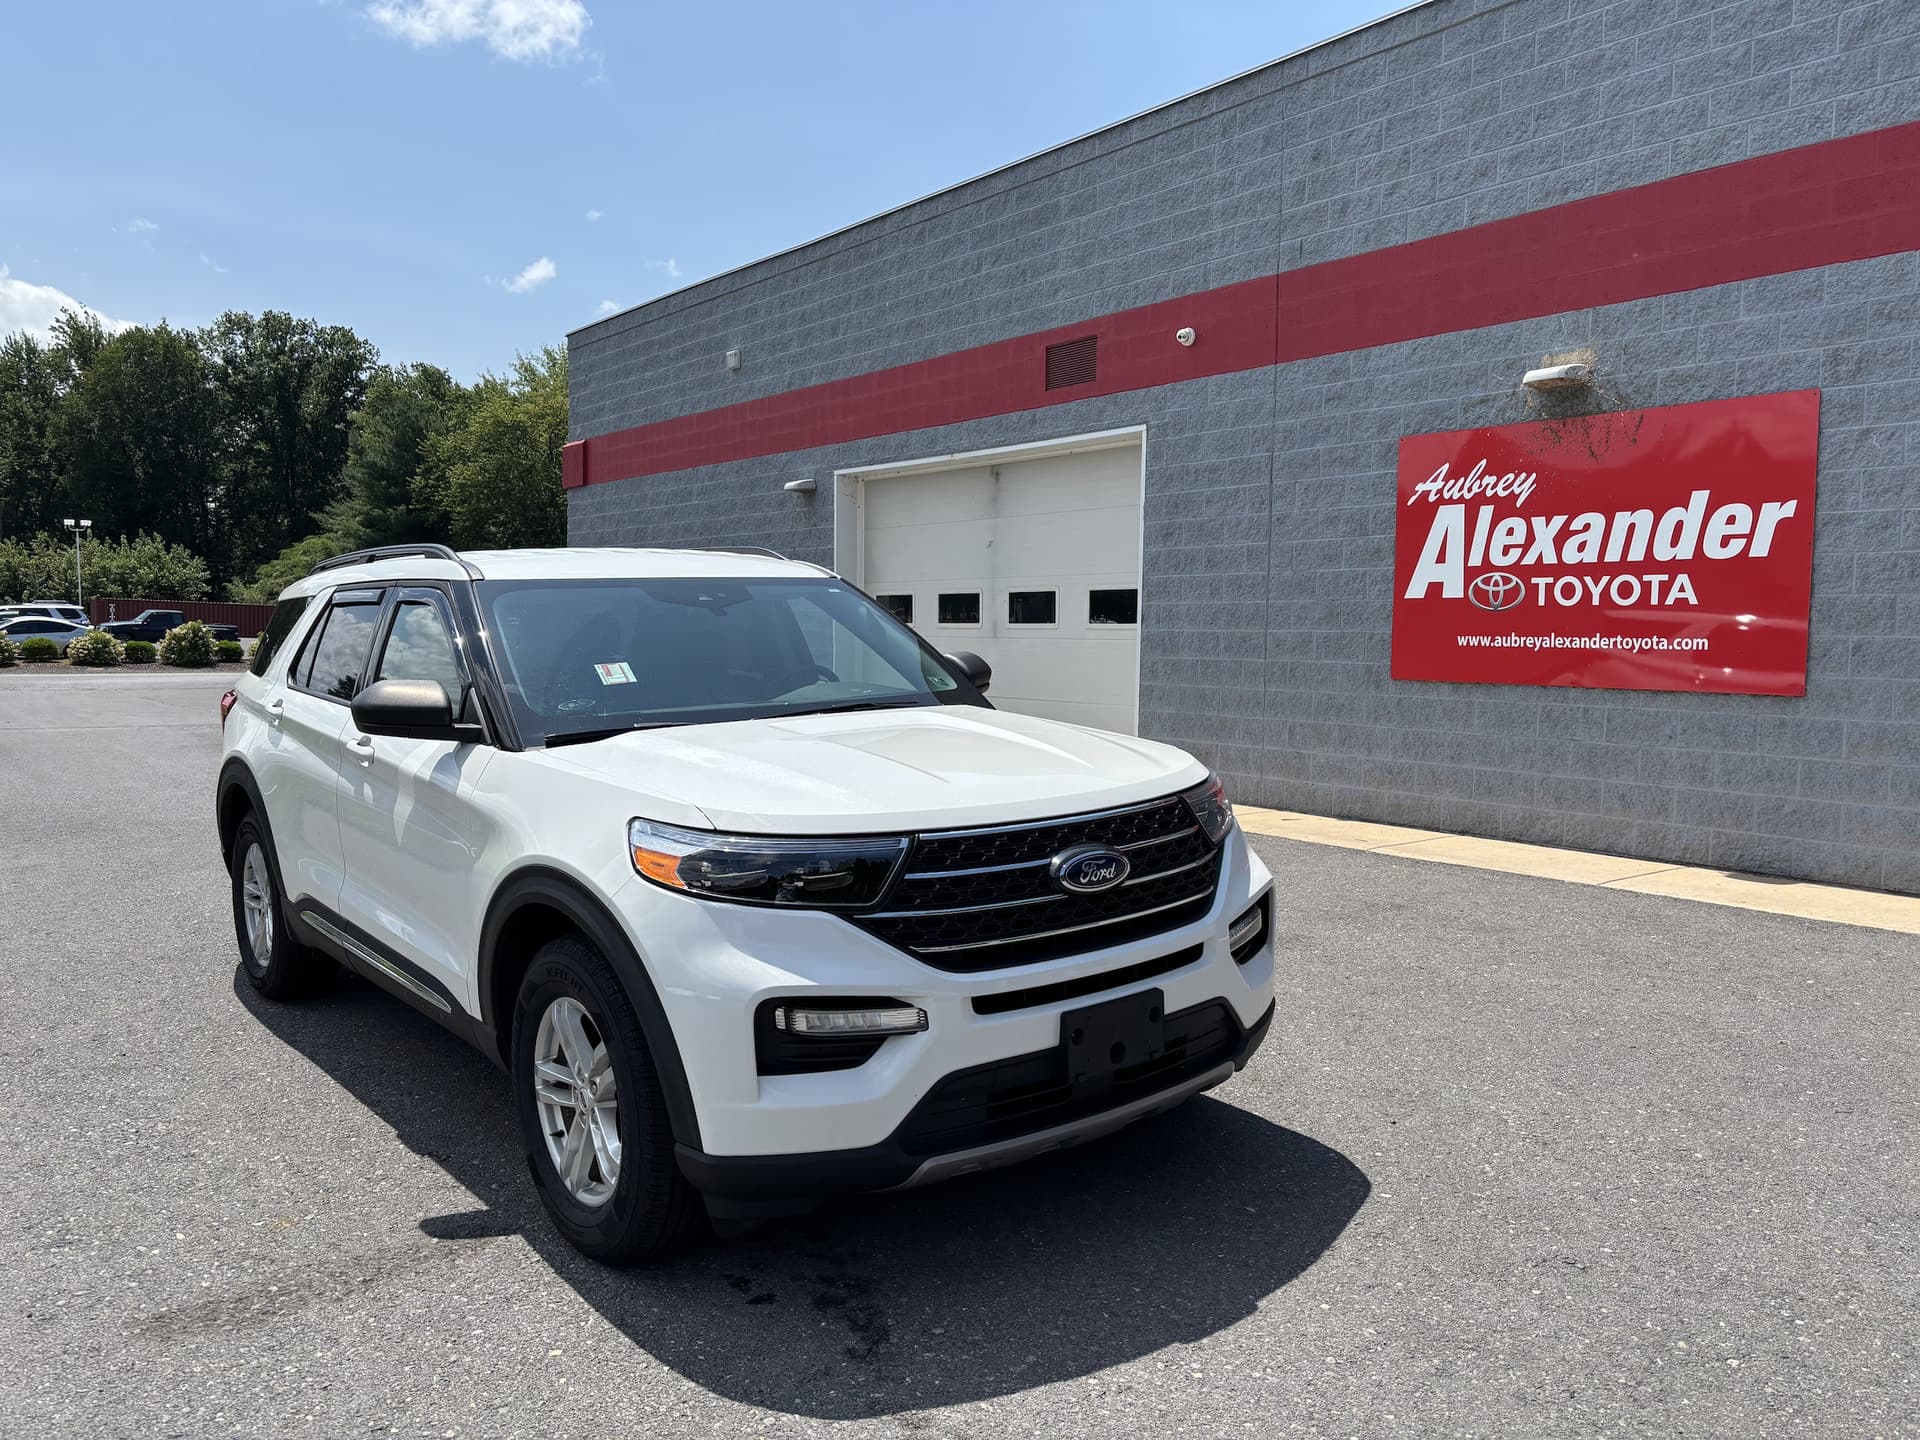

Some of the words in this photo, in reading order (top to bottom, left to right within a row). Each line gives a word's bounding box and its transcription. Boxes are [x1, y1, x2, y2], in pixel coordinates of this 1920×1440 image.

[1407, 459, 1536, 508] Aubrey
[1403, 489, 1798, 599] Alexander
[1531, 574, 1699, 607] TOYOTA
[1457, 632, 1709, 653] www.aubreyalexandertoyota.com
[1080, 859, 1116, 884] Ford
